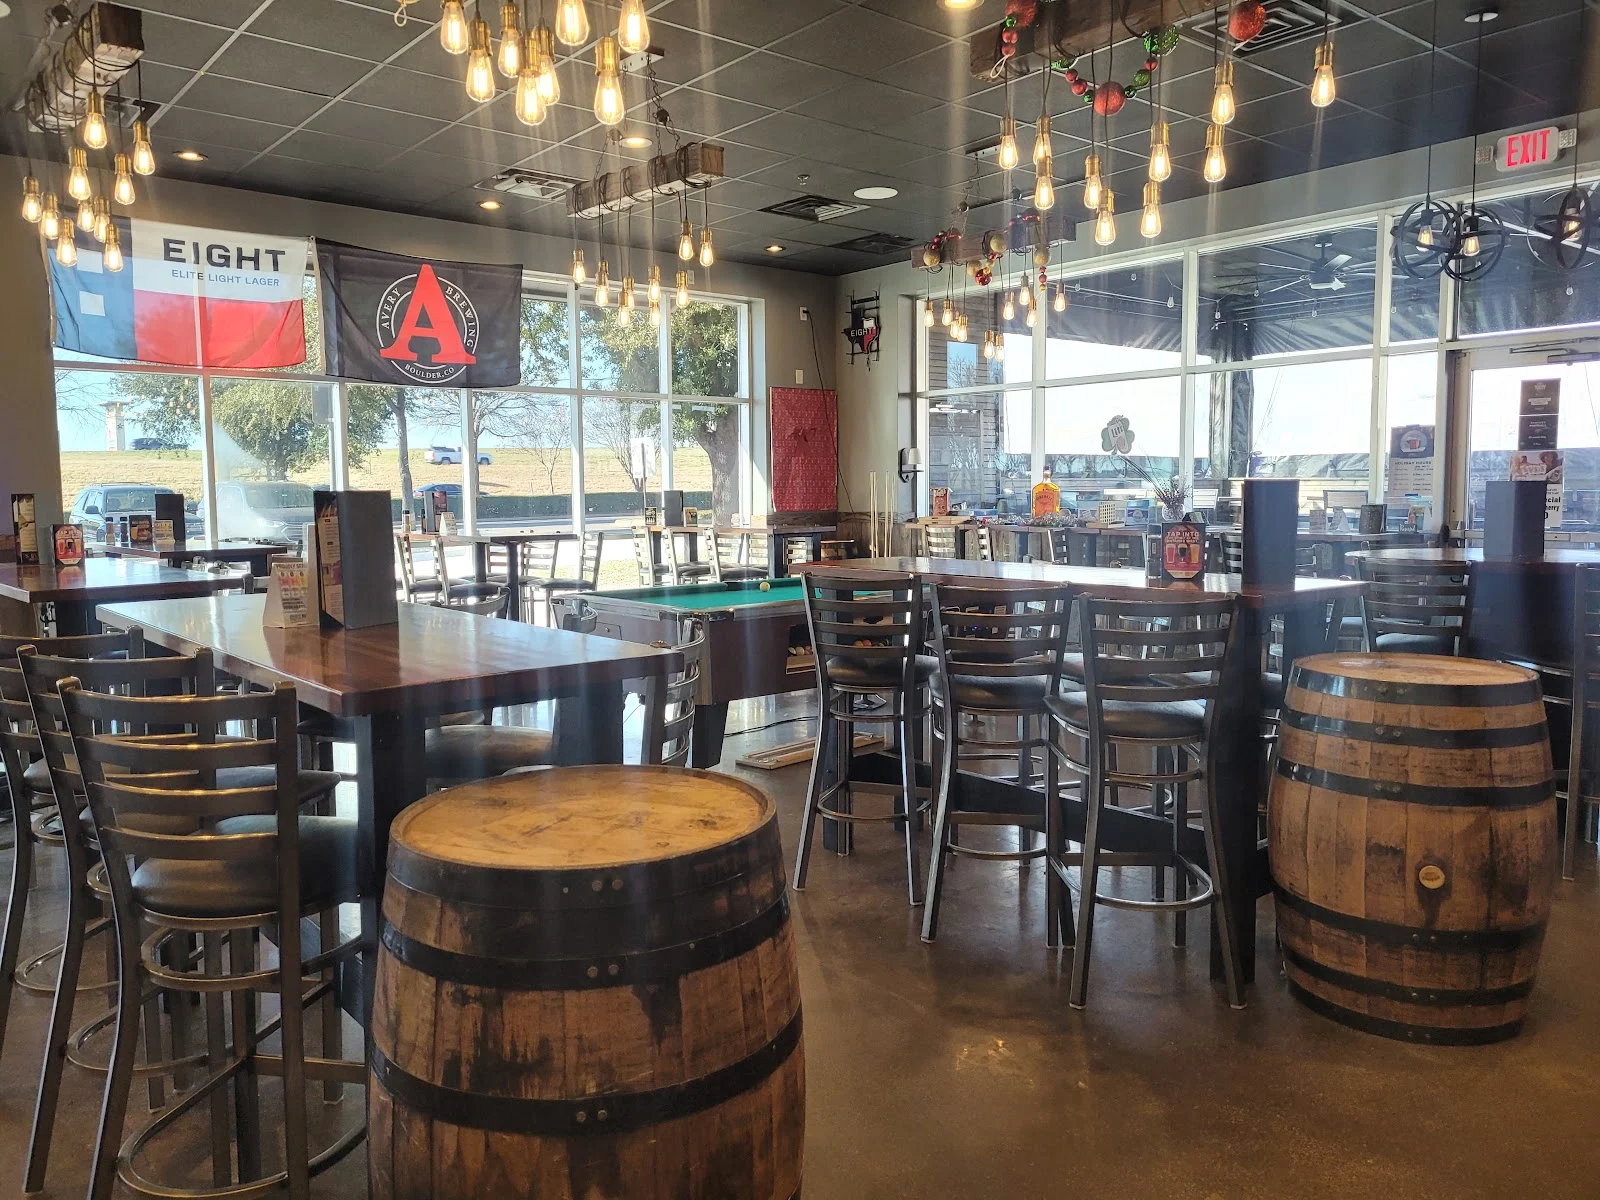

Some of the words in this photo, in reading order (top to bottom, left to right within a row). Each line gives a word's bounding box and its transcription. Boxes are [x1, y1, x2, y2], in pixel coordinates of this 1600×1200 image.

[1507, 130, 1550, 167] EXIT
[162, 238, 286, 272] EIGHT
[171, 269, 204, 280] ELITE
[208, 273, 241, 284] LIGHT
[245, 276, 280, 287] LAGER
[380, 263, 477, 364] A
[381, 287, 401, 330] AVERY
[445, 285, 477, 347] BREWING
[851, 328, 873, 336] EIGHT
